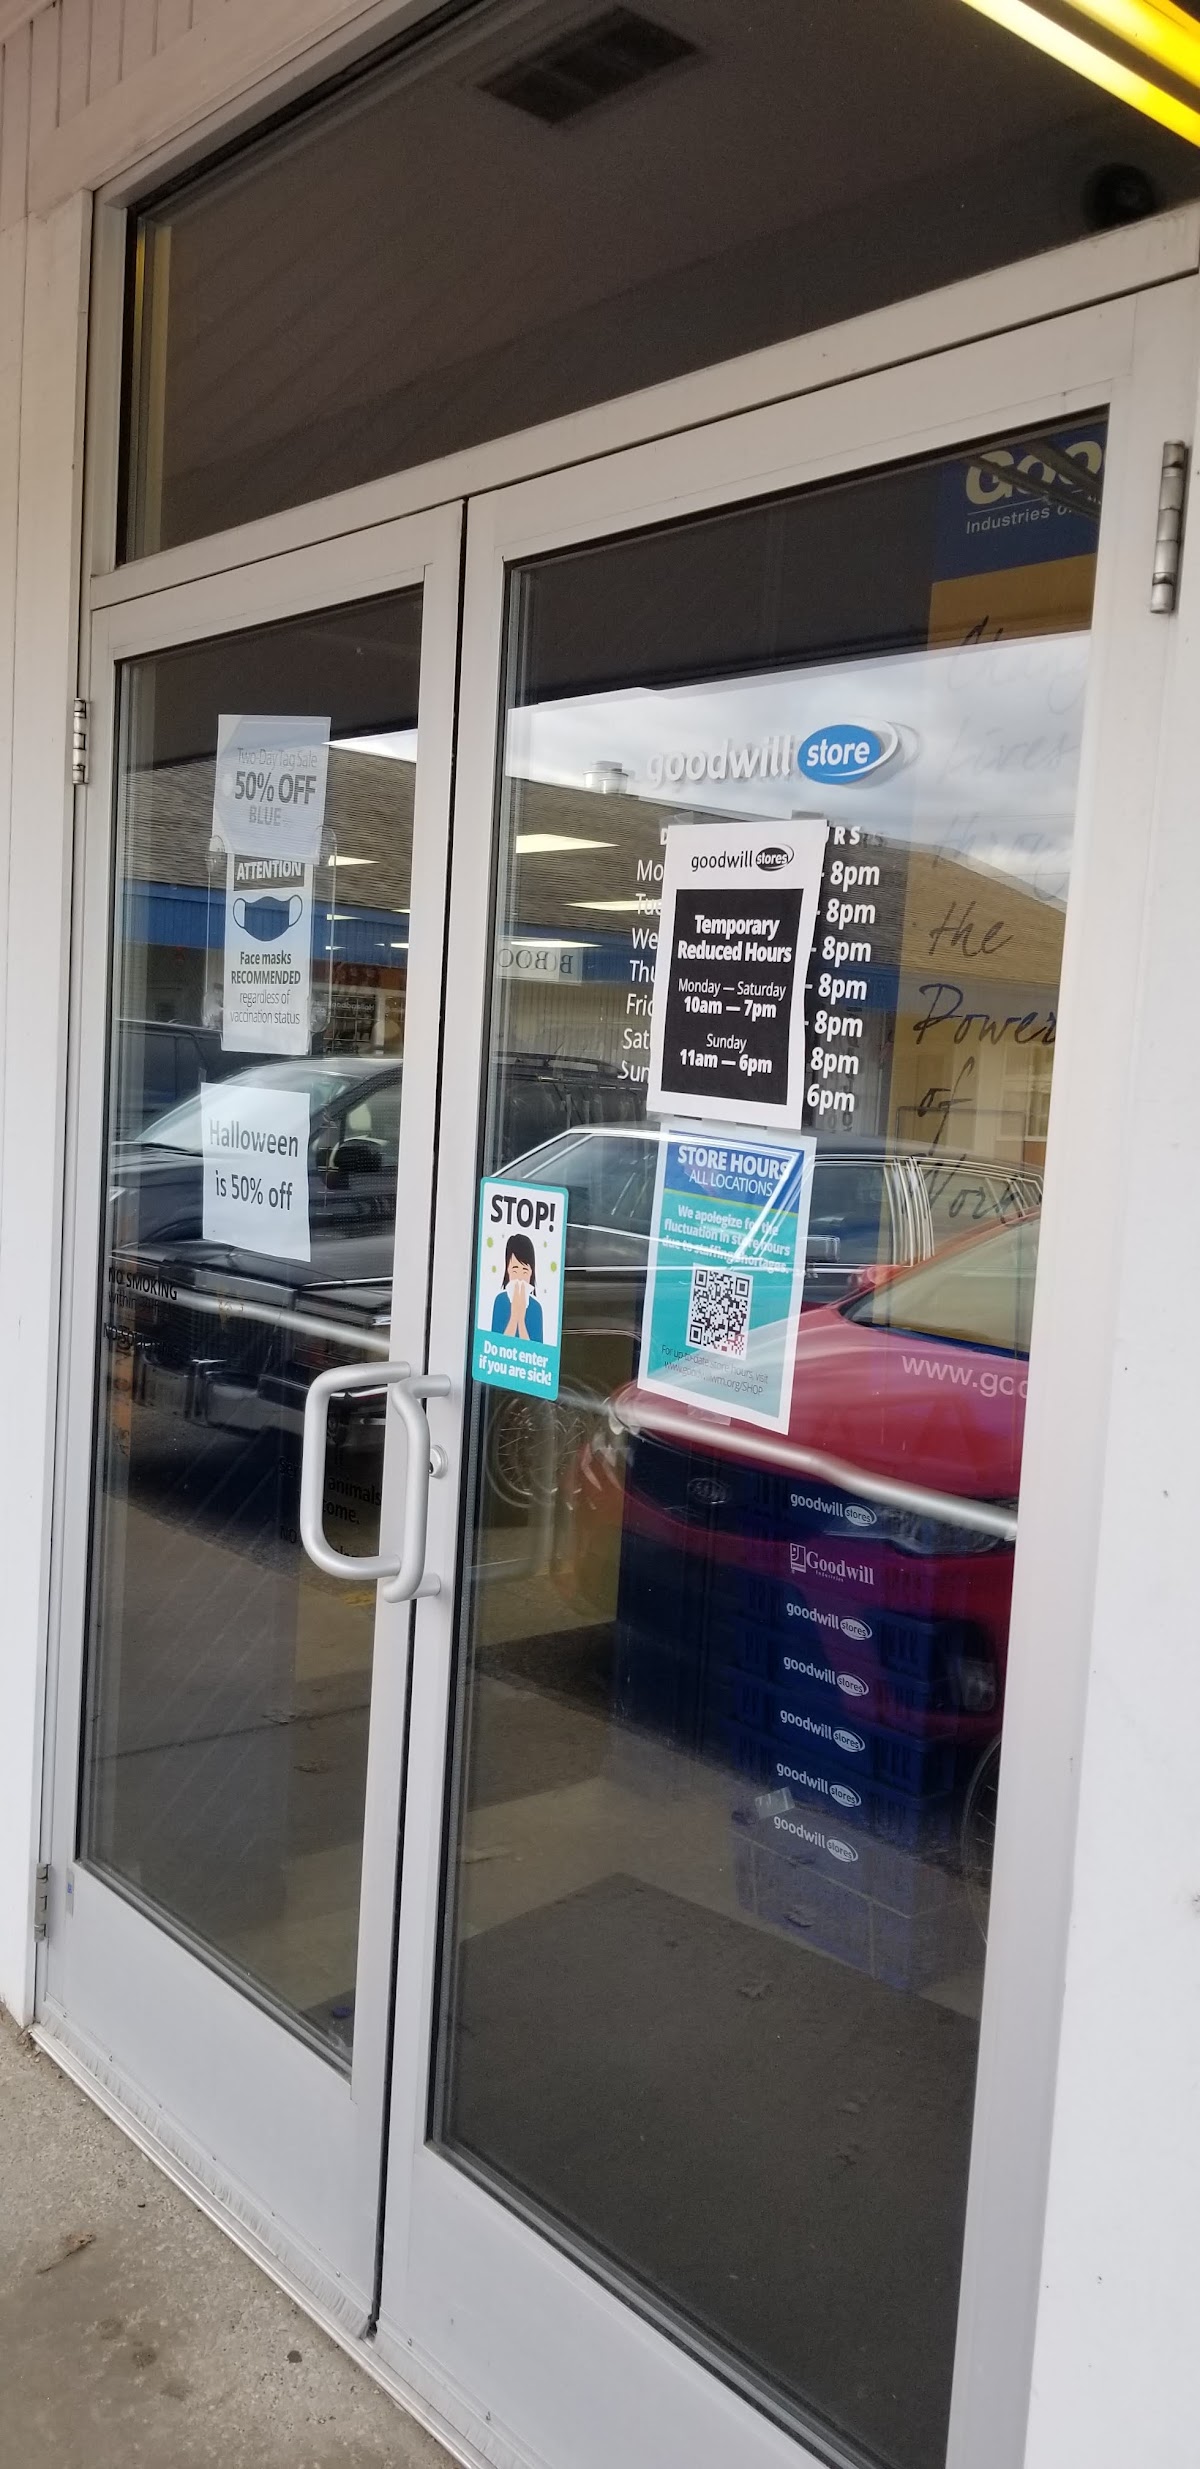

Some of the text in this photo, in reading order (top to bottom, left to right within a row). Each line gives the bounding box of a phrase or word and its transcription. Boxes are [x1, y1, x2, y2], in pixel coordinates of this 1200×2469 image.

[966, 507, 1050, 534] Industries
[279, 750, 296, 770] Tag
[297, 750, 317, 767] Sale
[648, 735, 870, 788] goodwill store
[234, 771, 317, 805] 50% OFF
[249, 805, 282, 826] BLUE
[236, 860, 301, 881] ATTENTION
[691, 850, 788, 872] goodwill stores
[830, 861, 880, 893] 8pm
[695, 914, 780, 941] Temporary
[826, 898, 876, 930] 8pm
[240, 950, 292, 965] Face masks
[677, 940, 792, 963] Reduced Hours
[822, 936, 871, 968] 8pm
[231, 970, 301, 985] RECOMMENDED
[678, 978, 721, 997] Monday
[736, 981, 787, 1001] Saturday
[818, 973, 867, 1005] 8pm
[240, 989, 291, 1007] regardless of
[684, 996, 722, 1014] 10am
[744, 999, 777, 1022] 7pm
[231, 1009, 300, 1025] vaccination status
[814, 1010, 863, 1042] 8pm
[706, 1033, 747, 1053] Sunday
[680, 1048, 718, 1068] 11am
[739, 1054, 773, 1077] 6pm
[810, 1047, 859, 1079] 8pm
[807, 1084, 855, 1115] 6pm
[209, 1119, 299, 1157] Halloween
[677, 1144, 790, 1180] STORE HOURS
[215, 1170, 293, 1210] is 50% off
[689, 1169, 773, 1197] ALL LOCATIONS
[490, 1194, 556, 1233] STOP!
[678, 1204, 694, 1218] We
[695, 1210, 742, 1229] apologize
[744, 1218, 759, 1231] fo
[664, 1218, 718, 1241] fluctuation
[720, 1231, 730, 1243] in
[731, 1235, 760, 1249] stre
[109, 1267, 178, 1300] NO SMOKING
[484, 1340, 548, 1368] Do not enter
[662, 1344, 672, 1356] For
[479, 1355, 552, 1386] if you are sick!
[328, 1477, 381, 1506] animals
[790, 1493, 871, 1522] goodwill stores
[806, 1551, 874, 1585] Goodwill
[786, 1602, 866, 1636] goodwill stores
[783, 1656, 862, 1693] goodwill stores
[780, 1710, 859, 1749] goodwill stores
[776, 1763, 856, 1803] goodwill stores
[773, 1816, 852, 1858] goodwill stores
